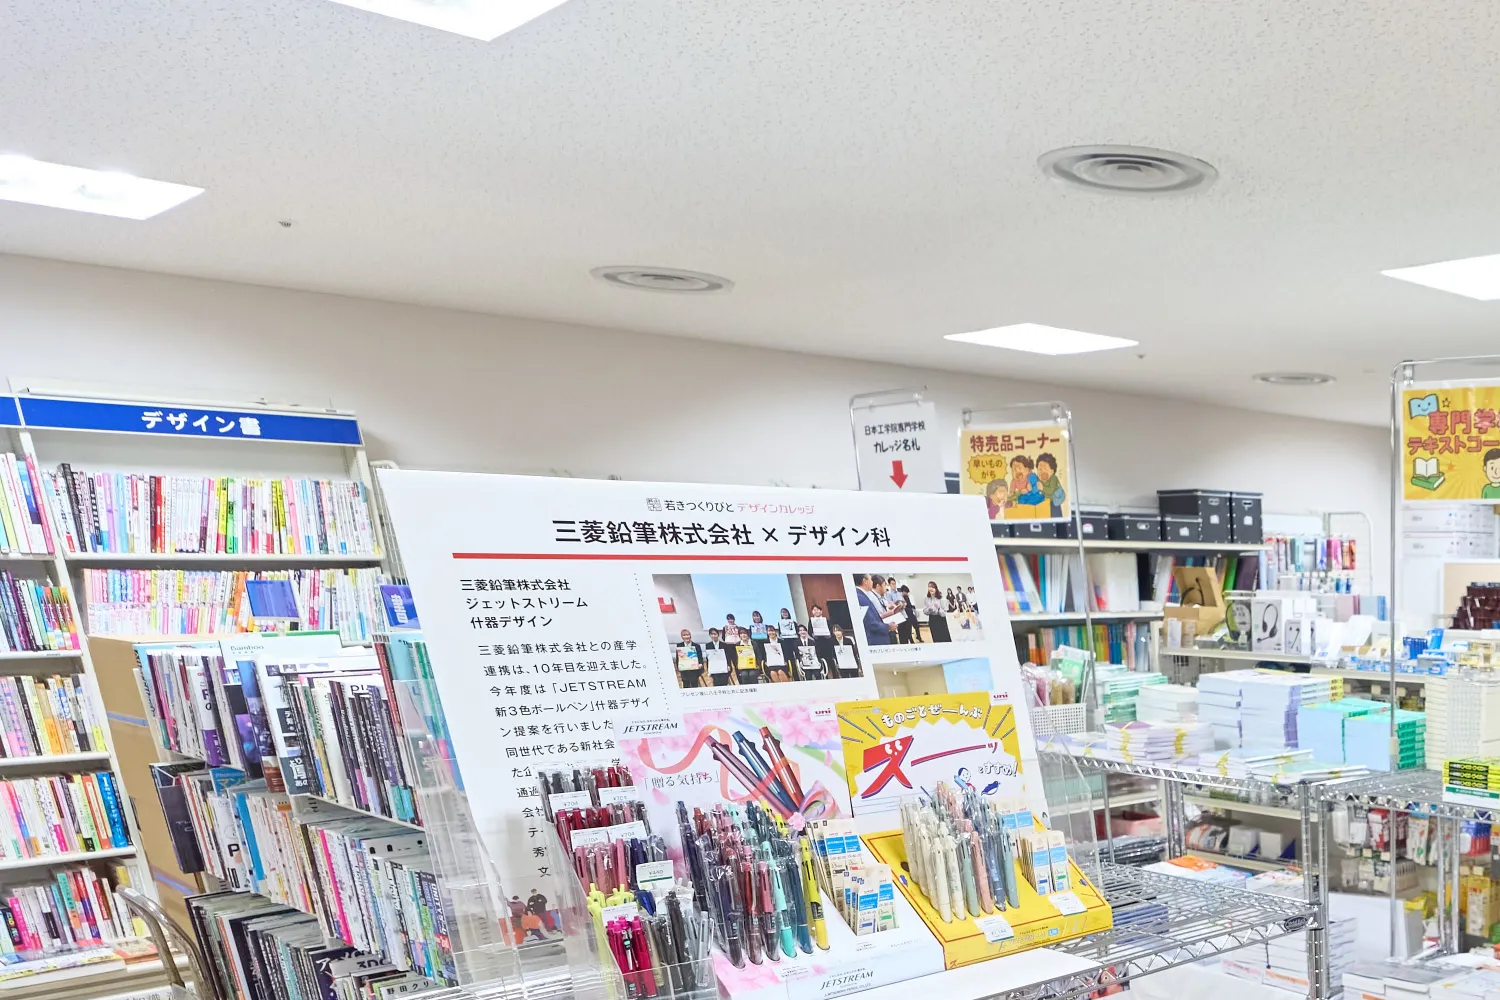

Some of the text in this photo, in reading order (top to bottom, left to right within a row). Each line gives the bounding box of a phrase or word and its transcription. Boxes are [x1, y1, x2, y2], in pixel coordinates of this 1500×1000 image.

[141, 411, 262, 436] デザイン書
[864, 420, 926, 437] 日本工学院専門学校
[873, 437, 921, 454] カレッジ名札
[970, 433, 1061, 453] 特売品コーナー
[973, 459, 1003, 469] 早いもの
[981, 470, 997, 480] がち
[664, 499, 735, 514] 若きつくりびと
[552, 520, 755, 546] 三菱鉛筆株式会社
[787, 525, 891, 548] デザイン科
[460, 578, 572, 592] 三菱鉛筆株式会社
[465, 596, 589, 610] ジェットストリーム
[470, 614, 553, 630] 什器デザイン
[230, 644, 265, 652] Bamboo
[477, 639, 638, 656] 三菱鉛筆株式会社との産学
[483, 659, 648, 677] 連携は、10年目を迎えました。
[494, 697, 651, 718] 新3色ボールペン」什器デザイ
[881, 703, 983, 728] ものごとぜーんぶ
[499, 719, 614, 739] ン提案を行いました
[622, 722, 679, 735] JETSTREAM
[504, 739, 616, 759] 同世代である新社会
[644, 771, 720, 791] 「贈る気持ち」
[820, 970, 874, 991] JETSTREAM
